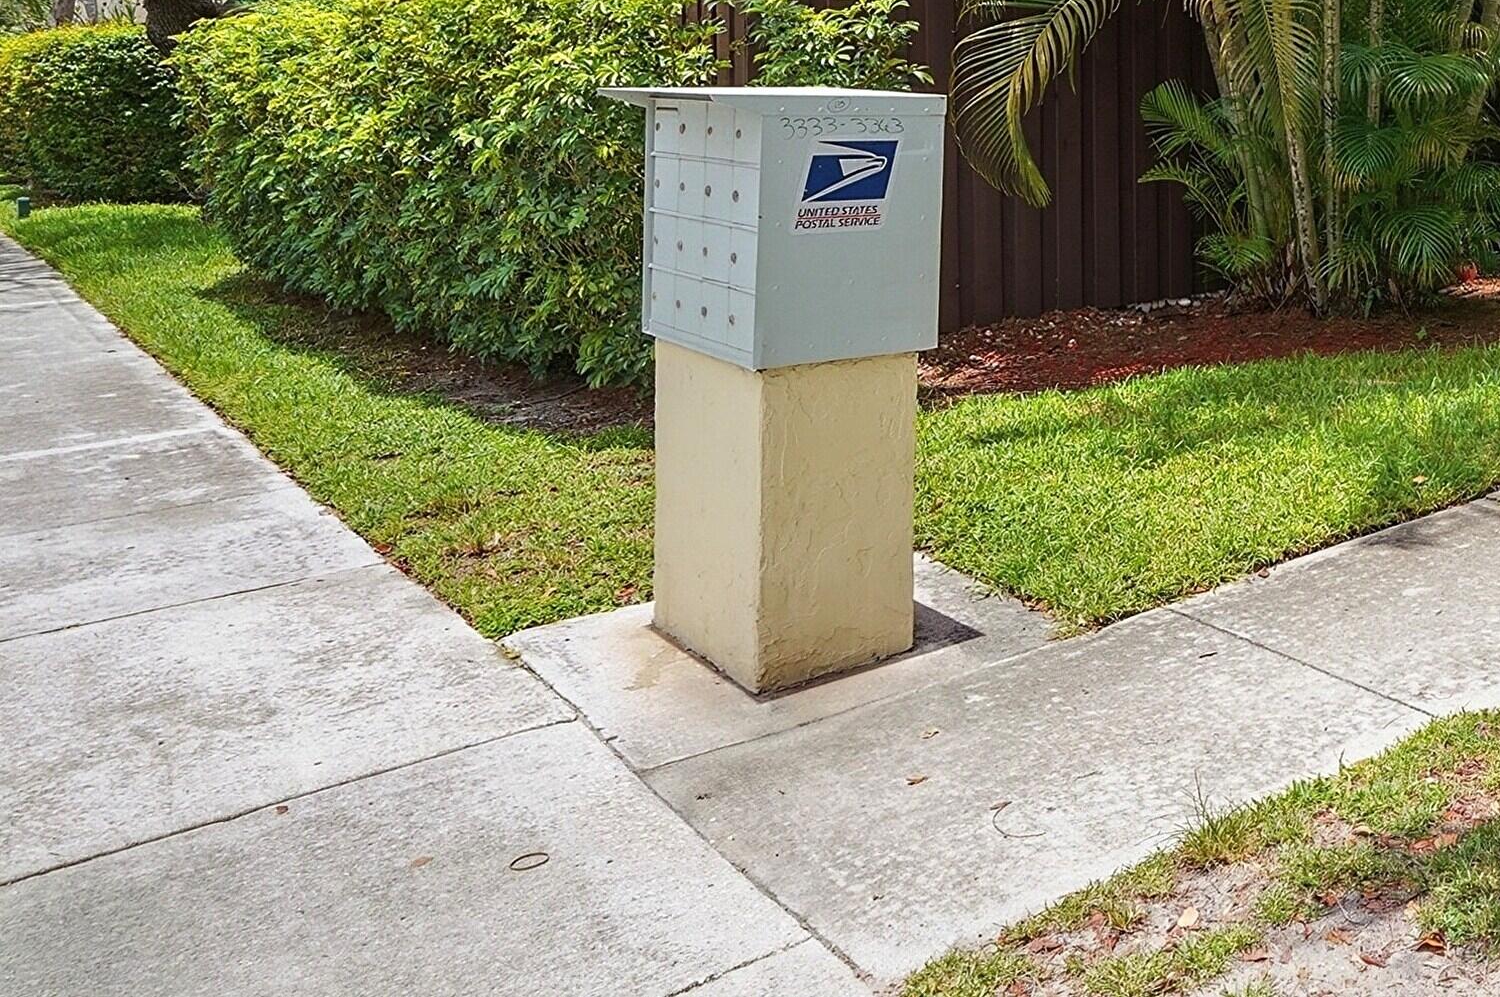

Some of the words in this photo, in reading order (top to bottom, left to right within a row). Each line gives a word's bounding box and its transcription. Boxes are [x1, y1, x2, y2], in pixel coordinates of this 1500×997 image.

[797, 207, 840, 218] UNITED
[841, 205, 878, 216] STATES
[795, 218, 836, 230] POSTAL
[838, 216, 881, 228] SERVICE
